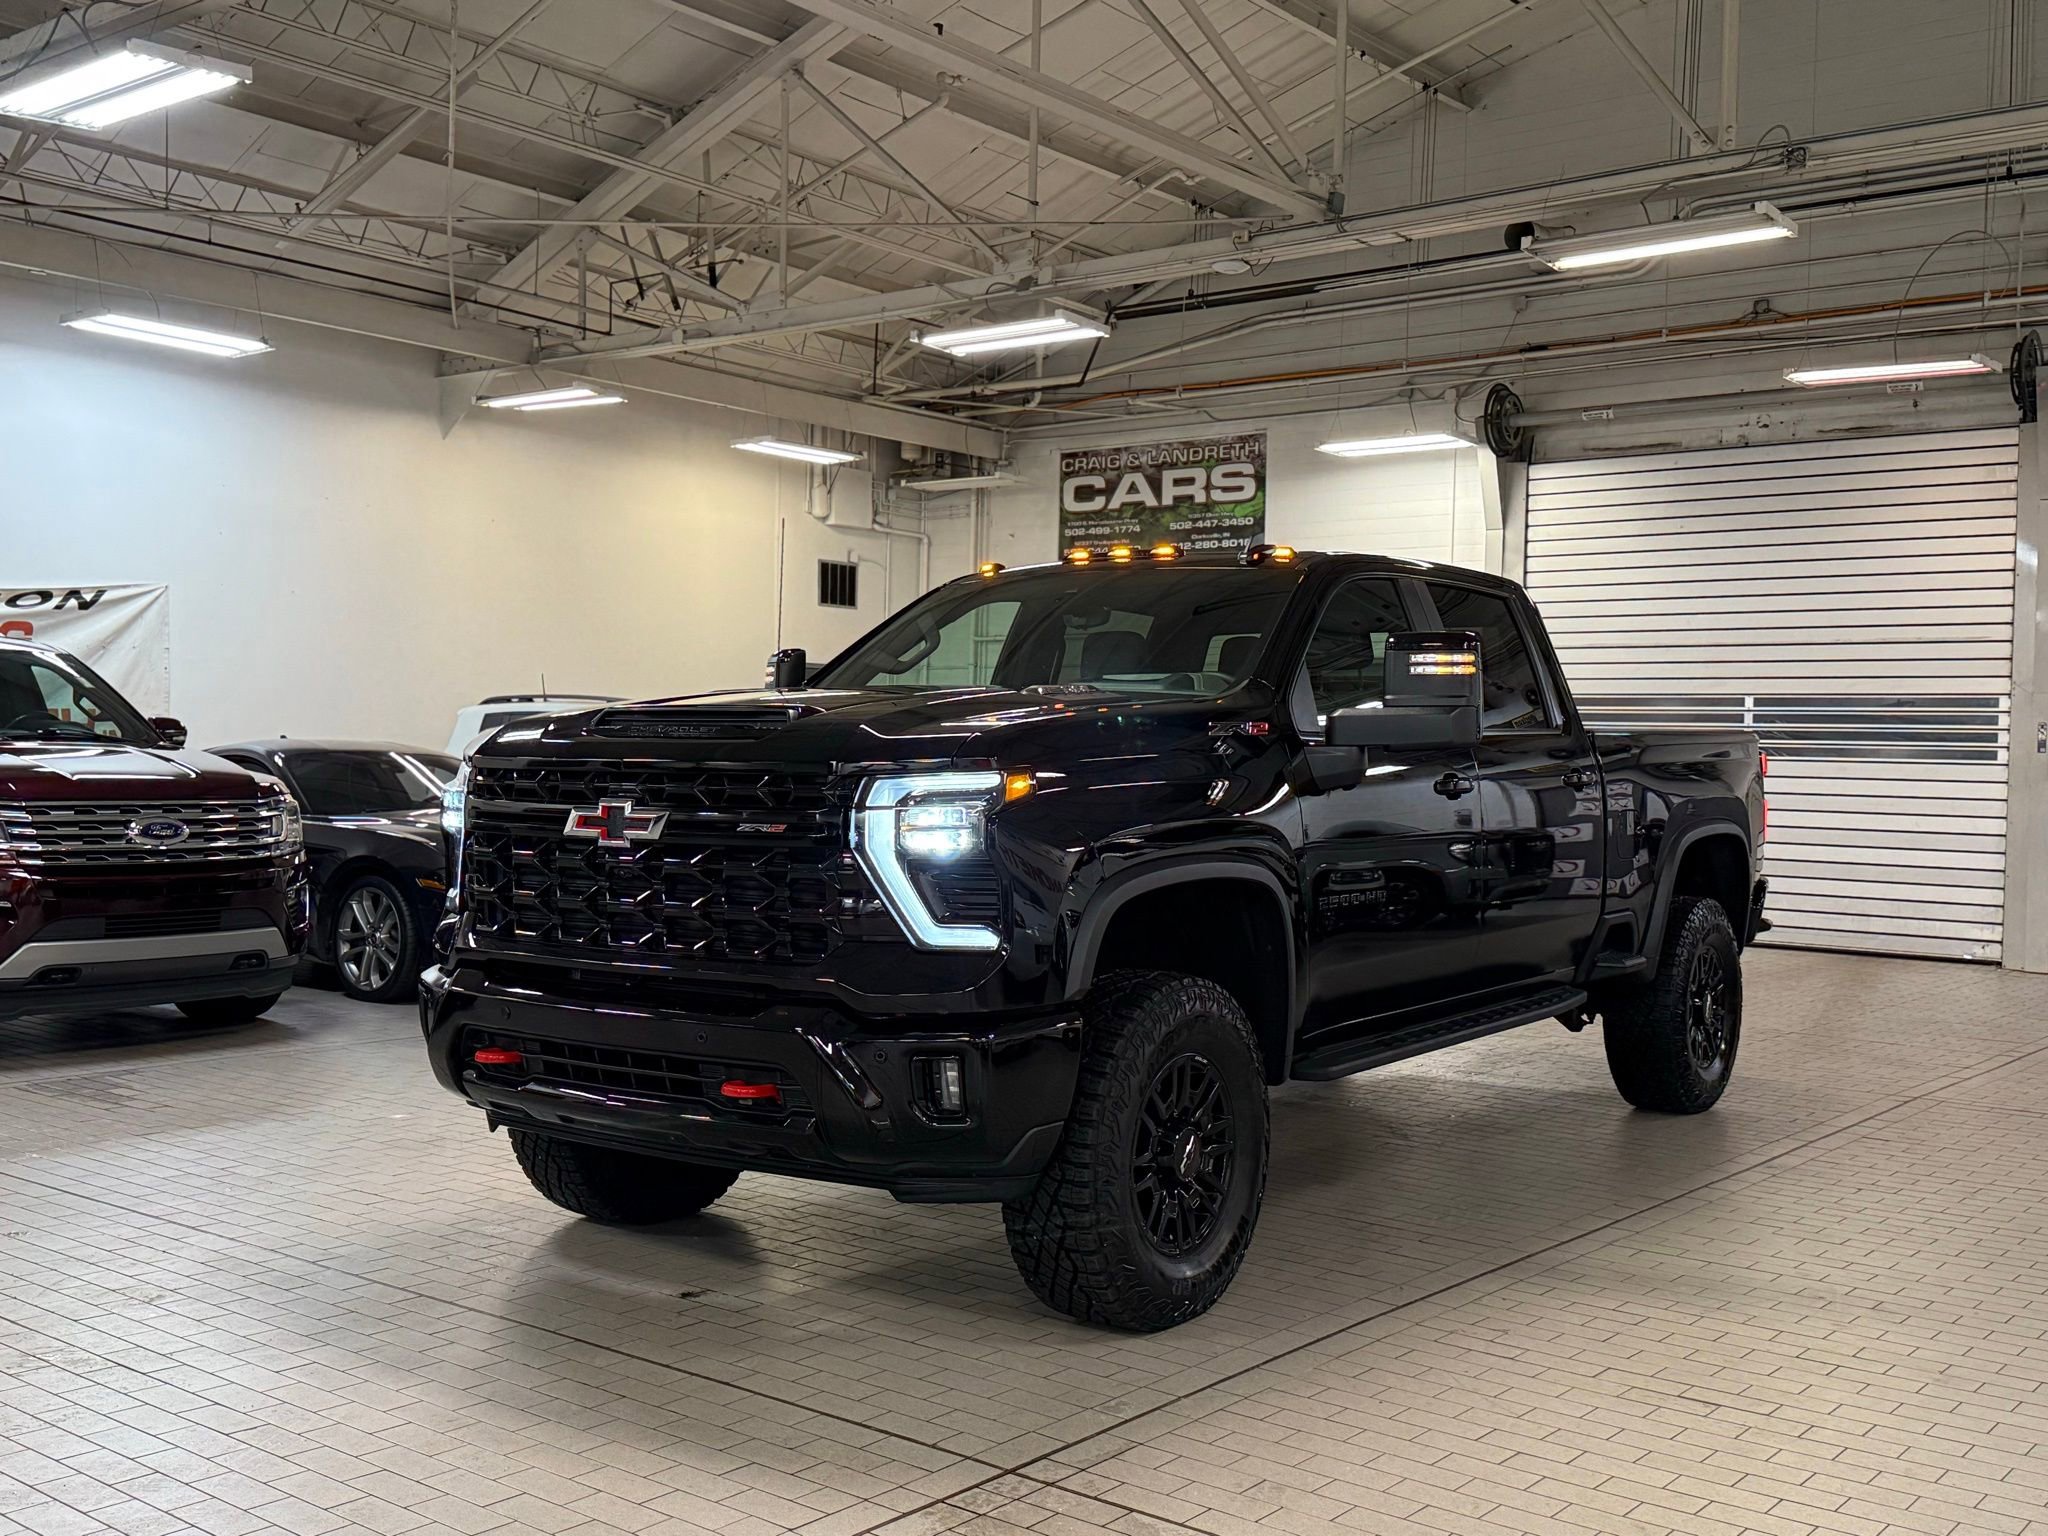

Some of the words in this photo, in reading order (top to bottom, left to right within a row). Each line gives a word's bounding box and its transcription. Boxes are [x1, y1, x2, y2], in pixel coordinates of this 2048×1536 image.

[1062, 454, 1121, 472] CRAIG
[1127, 452, 1141, 468] &
[1147, 442, 1260, 466] LANDRETH
[1062, 462, 1257, 512] CARS
[1169, 517, 1254, 530] 502-447-3450
[1064, 525, 1141, 536] 502-499-1774
[1170, 538, 1250, 550] 12-280-801
[0, 590, 108, 611] ON
[736, 823, 788, 833] ZR2
